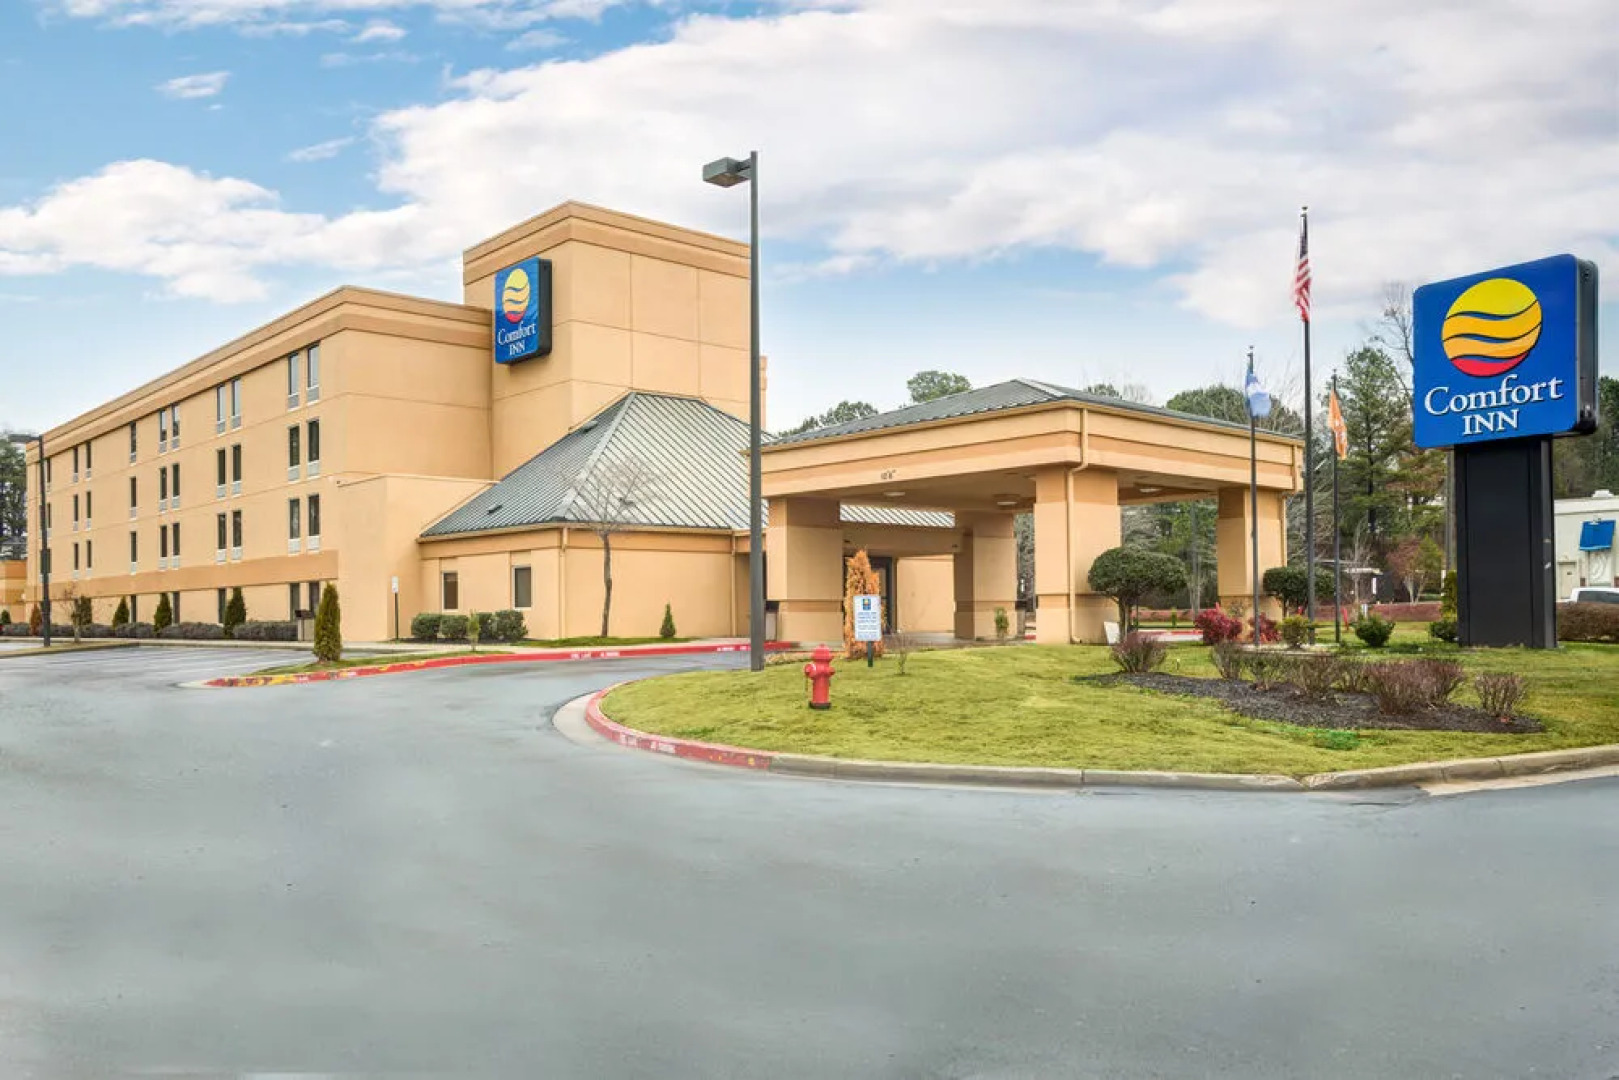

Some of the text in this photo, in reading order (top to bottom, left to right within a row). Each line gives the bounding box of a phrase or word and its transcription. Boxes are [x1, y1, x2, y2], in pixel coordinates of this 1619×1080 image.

[498, 320, 537, 346] Comfort
[509, 340, 525, 356] INN
[1424, 374, 1564, 416] Comfort
[1462, 408, 1520, 436] INN
